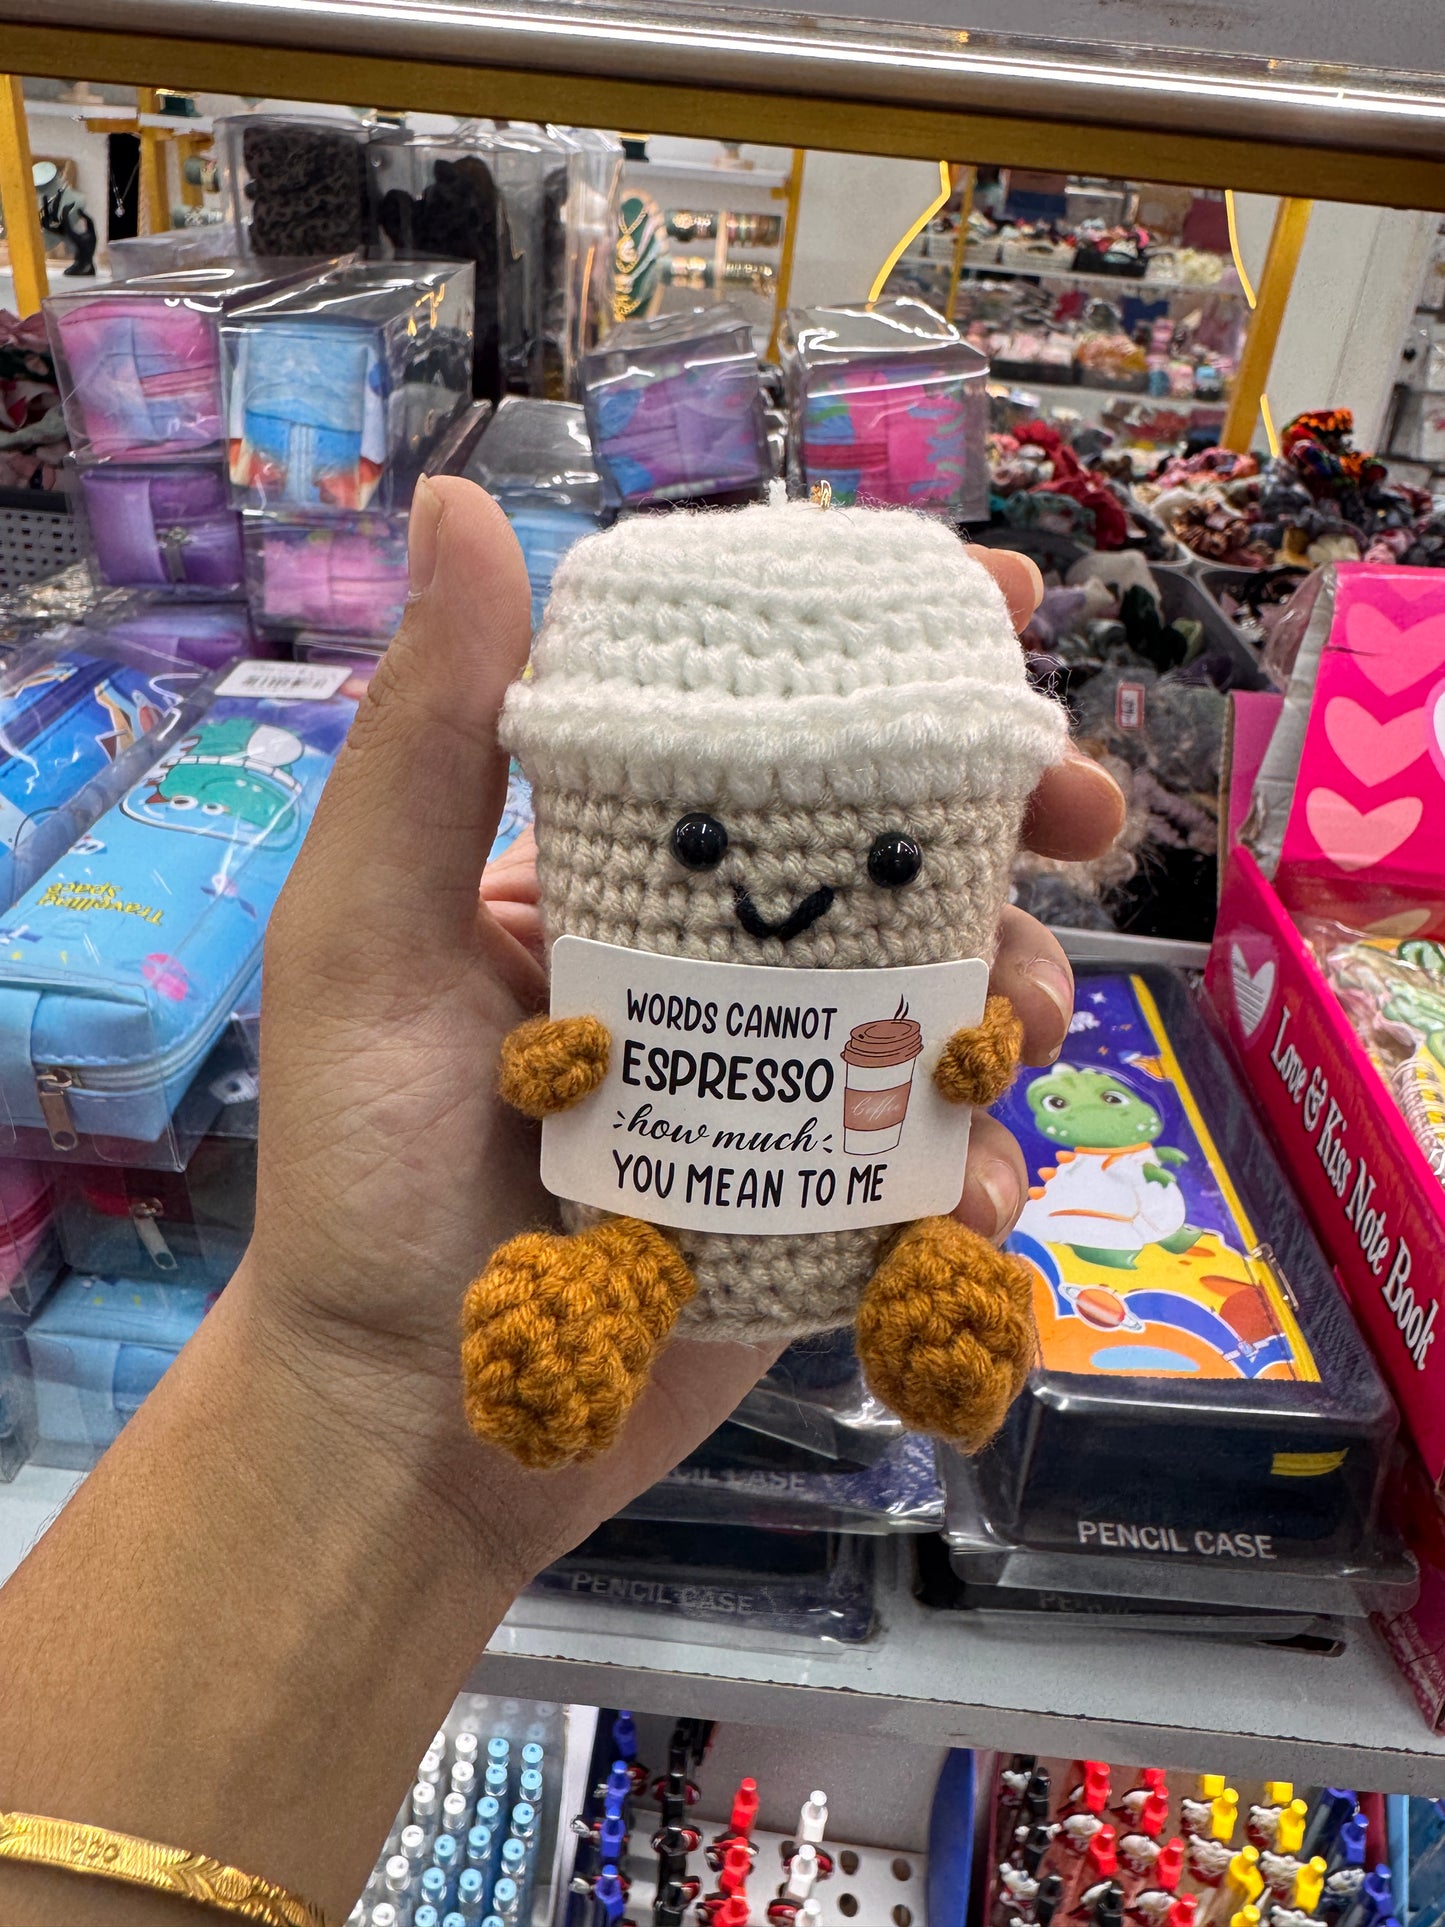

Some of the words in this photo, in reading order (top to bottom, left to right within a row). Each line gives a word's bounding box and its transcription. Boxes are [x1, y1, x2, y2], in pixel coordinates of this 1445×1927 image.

[37, 893, 163, 926] Travelling
[46, 881, 122, 898] Space
[627, 988, 718, 1034] WORDS
[726, 1002, 838, 1041] CANNOT
[622, 1039, 835, 1103] ESPRESSO
[627, 1103, 710, 1145] how
[711, 1116, 819, 1153] much
[612, 1149, 676, 1199] YOU
[685, 1163, 784, 1209] MEAN
[798, 1168, 836, 1208] TO
[846, 1163, 888, 1206] ME
[1270, 1005, 1308, 1105] Love
[1303, 1065, 1329, 1133] &
[1316, 1096, 1352, 1198] Kiss
[1344, 1157, 1391, 1276] Note
[1381, 1236, 1440, 1371] Book
[1077, 1520, 1189, 1553] PENCIL
[1194, 1530, 1278, 1560] CASE
[571, 1571, 673, 1605] PENCIL
